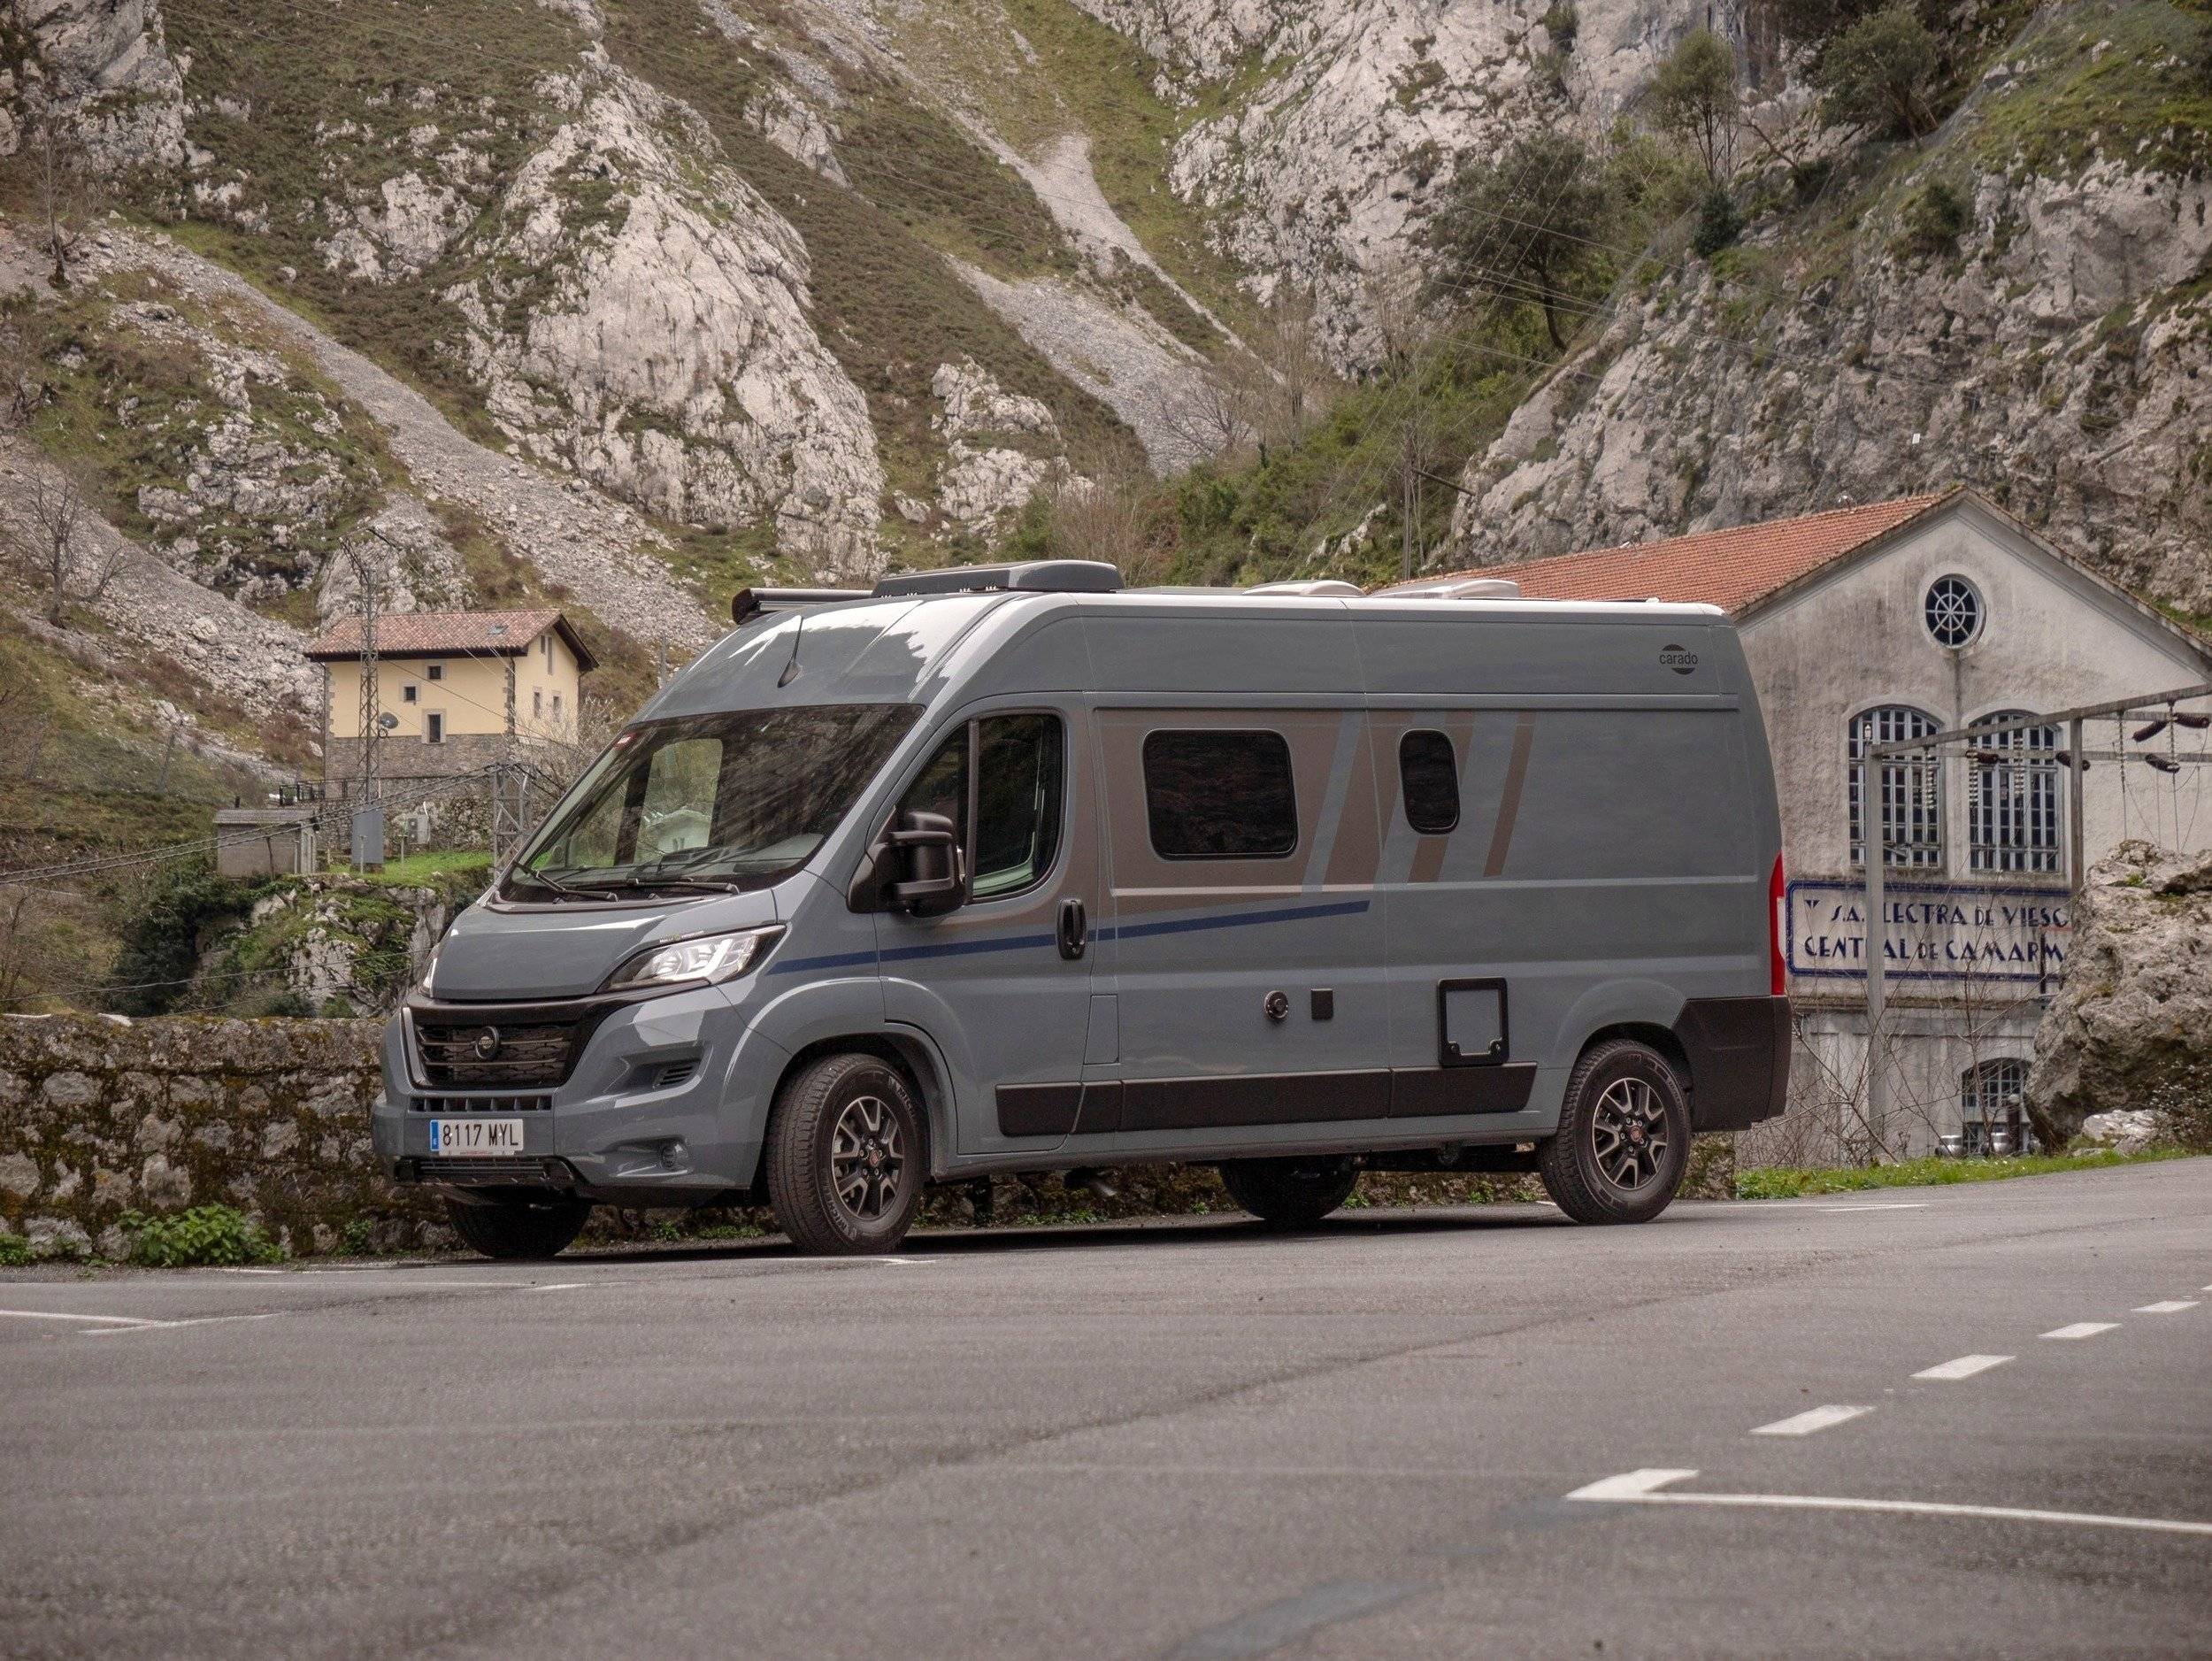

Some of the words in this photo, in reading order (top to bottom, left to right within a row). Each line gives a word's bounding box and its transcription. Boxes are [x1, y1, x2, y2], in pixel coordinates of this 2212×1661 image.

[1659, 651, 1699, 665] carado
[1831, 904, 1865, 922] S.A.
[1883, 901, 1968, 926] LECTRA
[1975, 905, 1994, 927] DE
[1804, 935, 1909, 959] CENTAL
[1917, 942, 1939, 959] DE
[1946, 939, 2064, 963] CAMARM
[443, 1123, 482, 1147] 8117
[488, 1123, 518, 1147] MYL
